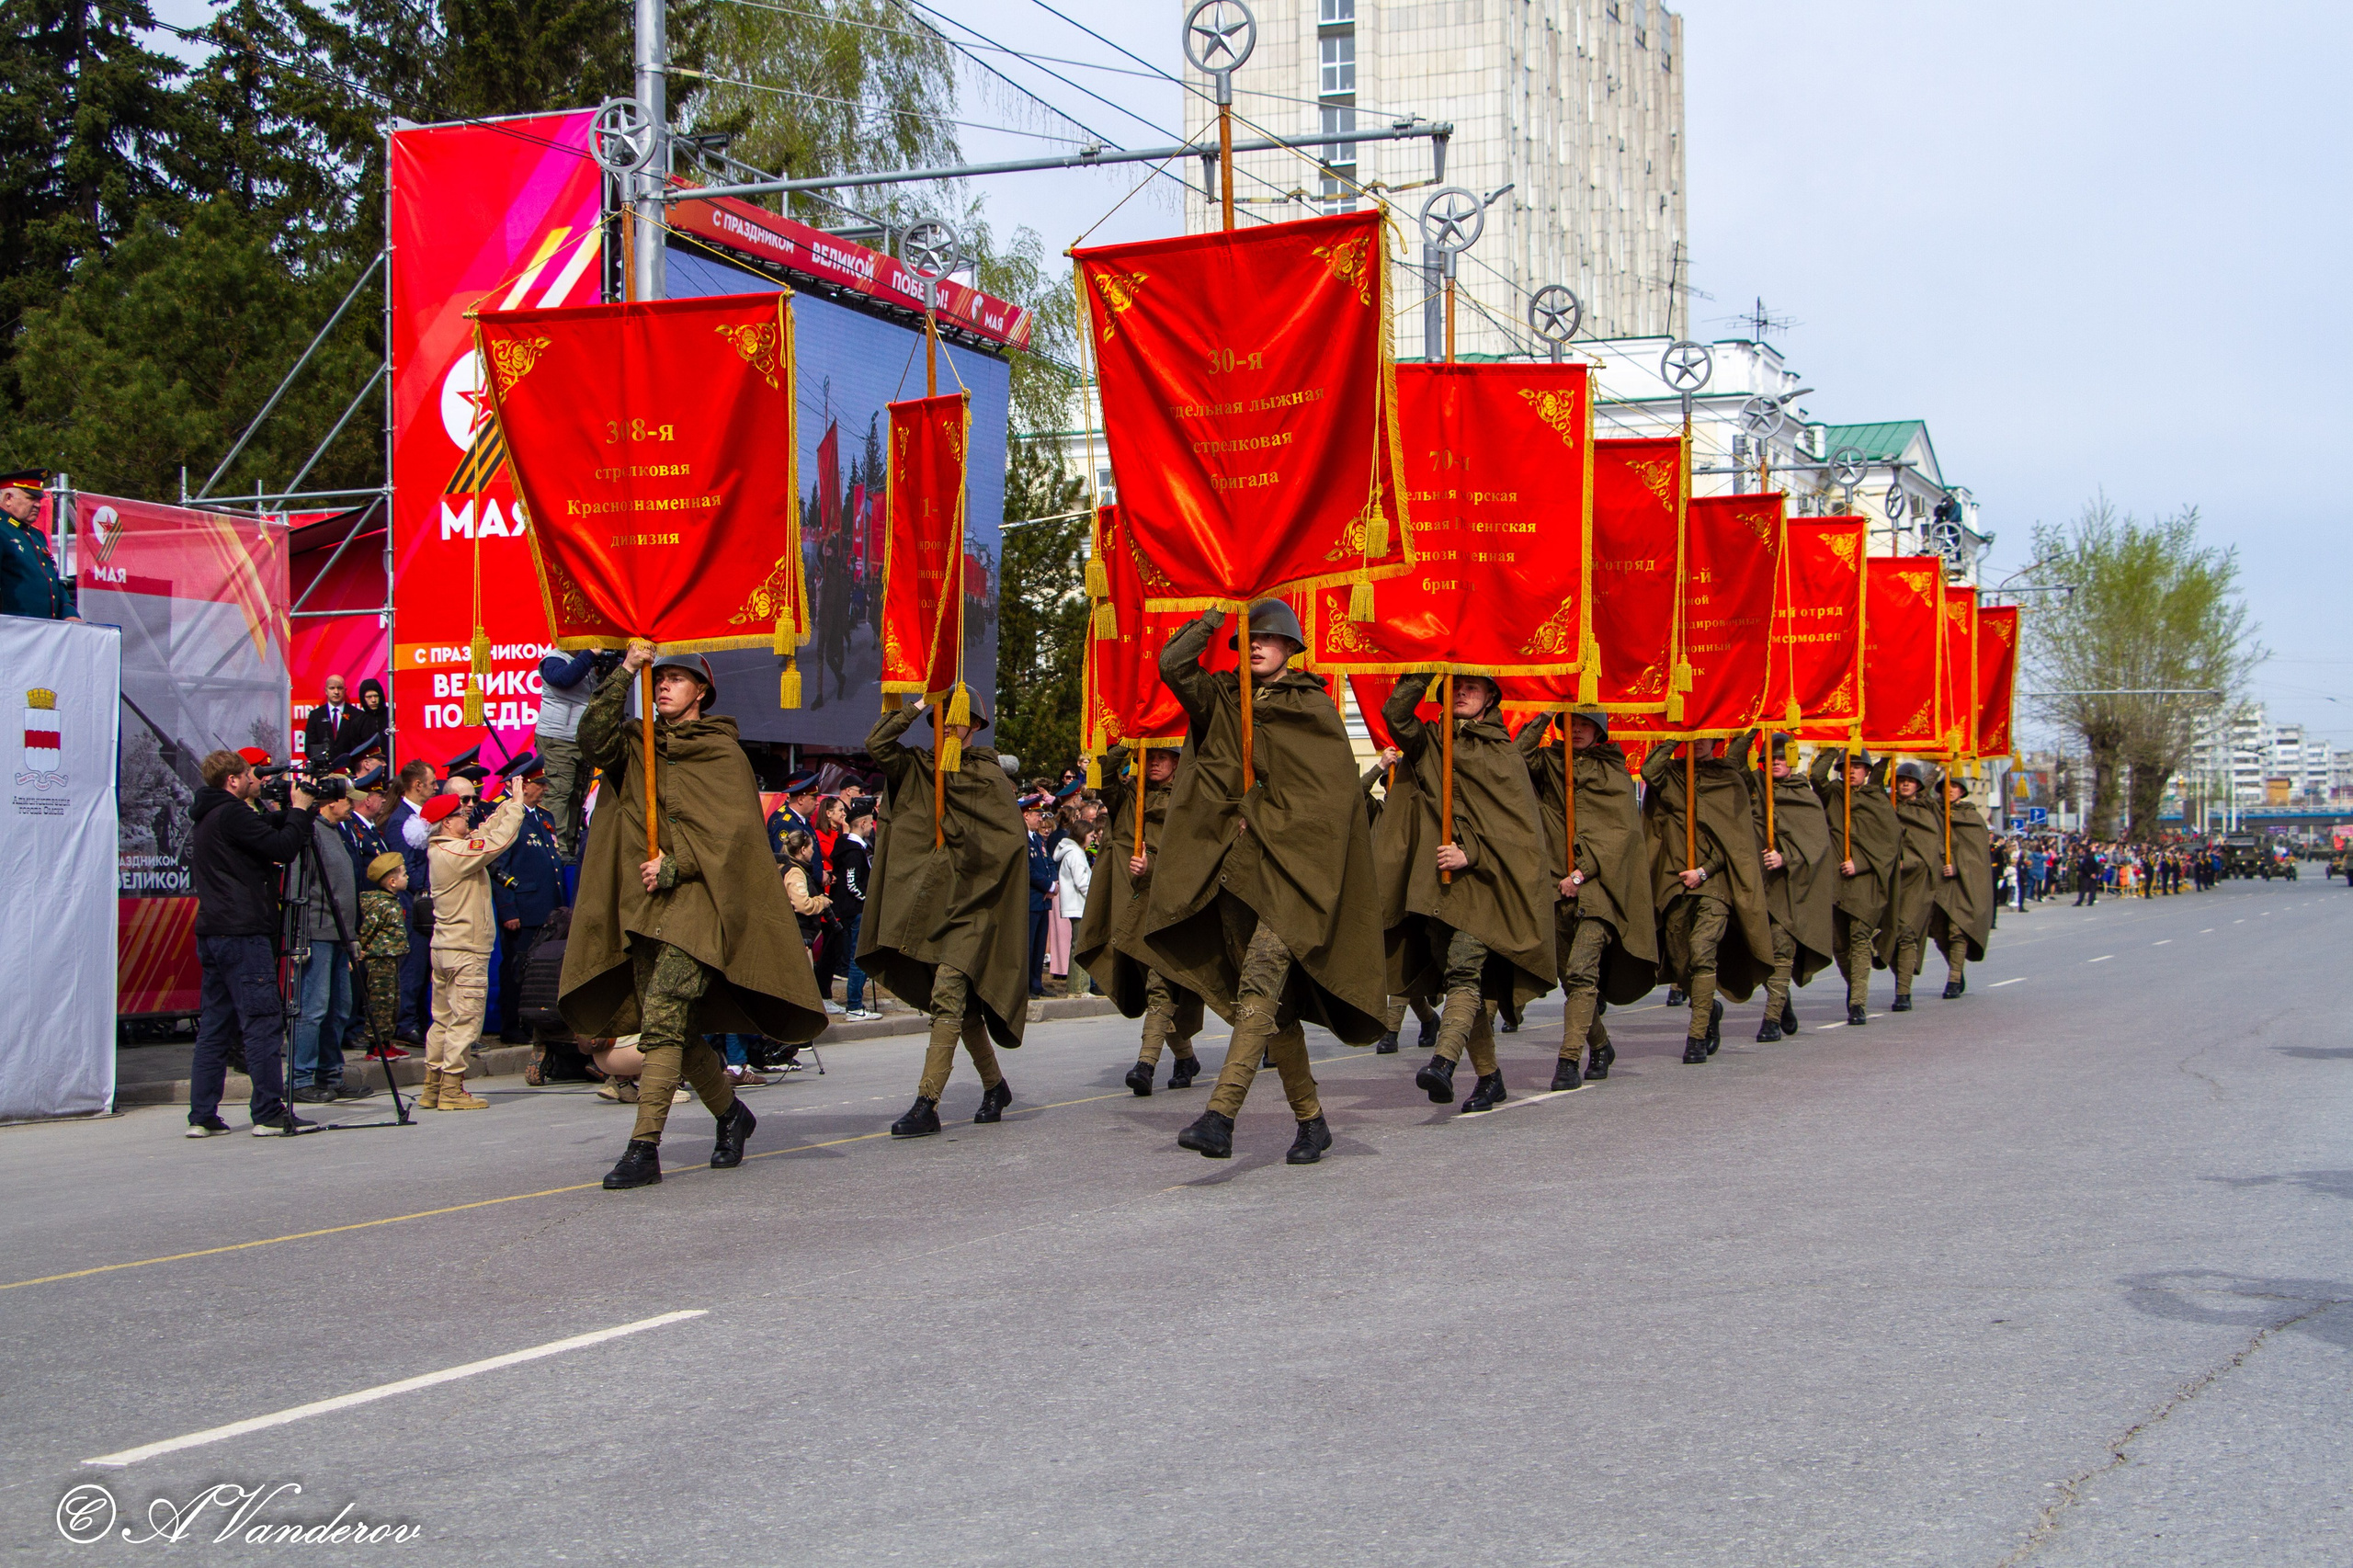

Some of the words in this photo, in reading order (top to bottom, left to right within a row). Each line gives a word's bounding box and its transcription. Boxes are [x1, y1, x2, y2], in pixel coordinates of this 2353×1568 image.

[712, 210, 722, 227] С
[723, 212, 795, 255] ПРАЗДНИКОМ
[812, 241, 874, 282] ВЕЛИКОЙ
[892, 269, 949, 310] ПОБЕЫ!
[984, 312, 1005, 333] МАЯ
[1207, 347, 1264, 375] 30-я
[1168, 401, 1244, 420] тдельная
[1248, 387, 1324, 413] лыжная
[606, 417, 676, 445] 308-я
[1192, 431, 1293, 457] стрелковая
[1210, 471, 1279, 494] бригада
[566, 494, 722, 518] Краснознаменная
[1406, 489, 1457, 502] ельная
[1462, 490, 1518, 506] орская
[440, 497, 531, 540] МАЯ
[1455, 516, 1537, 533] Пченгская
[610, 532, 680, 550] дивизия
[94, 564, 127, 584] МАЯ
[1605, 559, 1655, 574] отряд
[1800, 606, 1844, 619] отряд
[415, 648, 426, 665] С
[430, 642, 552, 663] ПРАЗНИКОМ
[433, 669, 543, 699] ВЕЛИКО
[119, 855, 179, 869] АЗДНИКОМ
